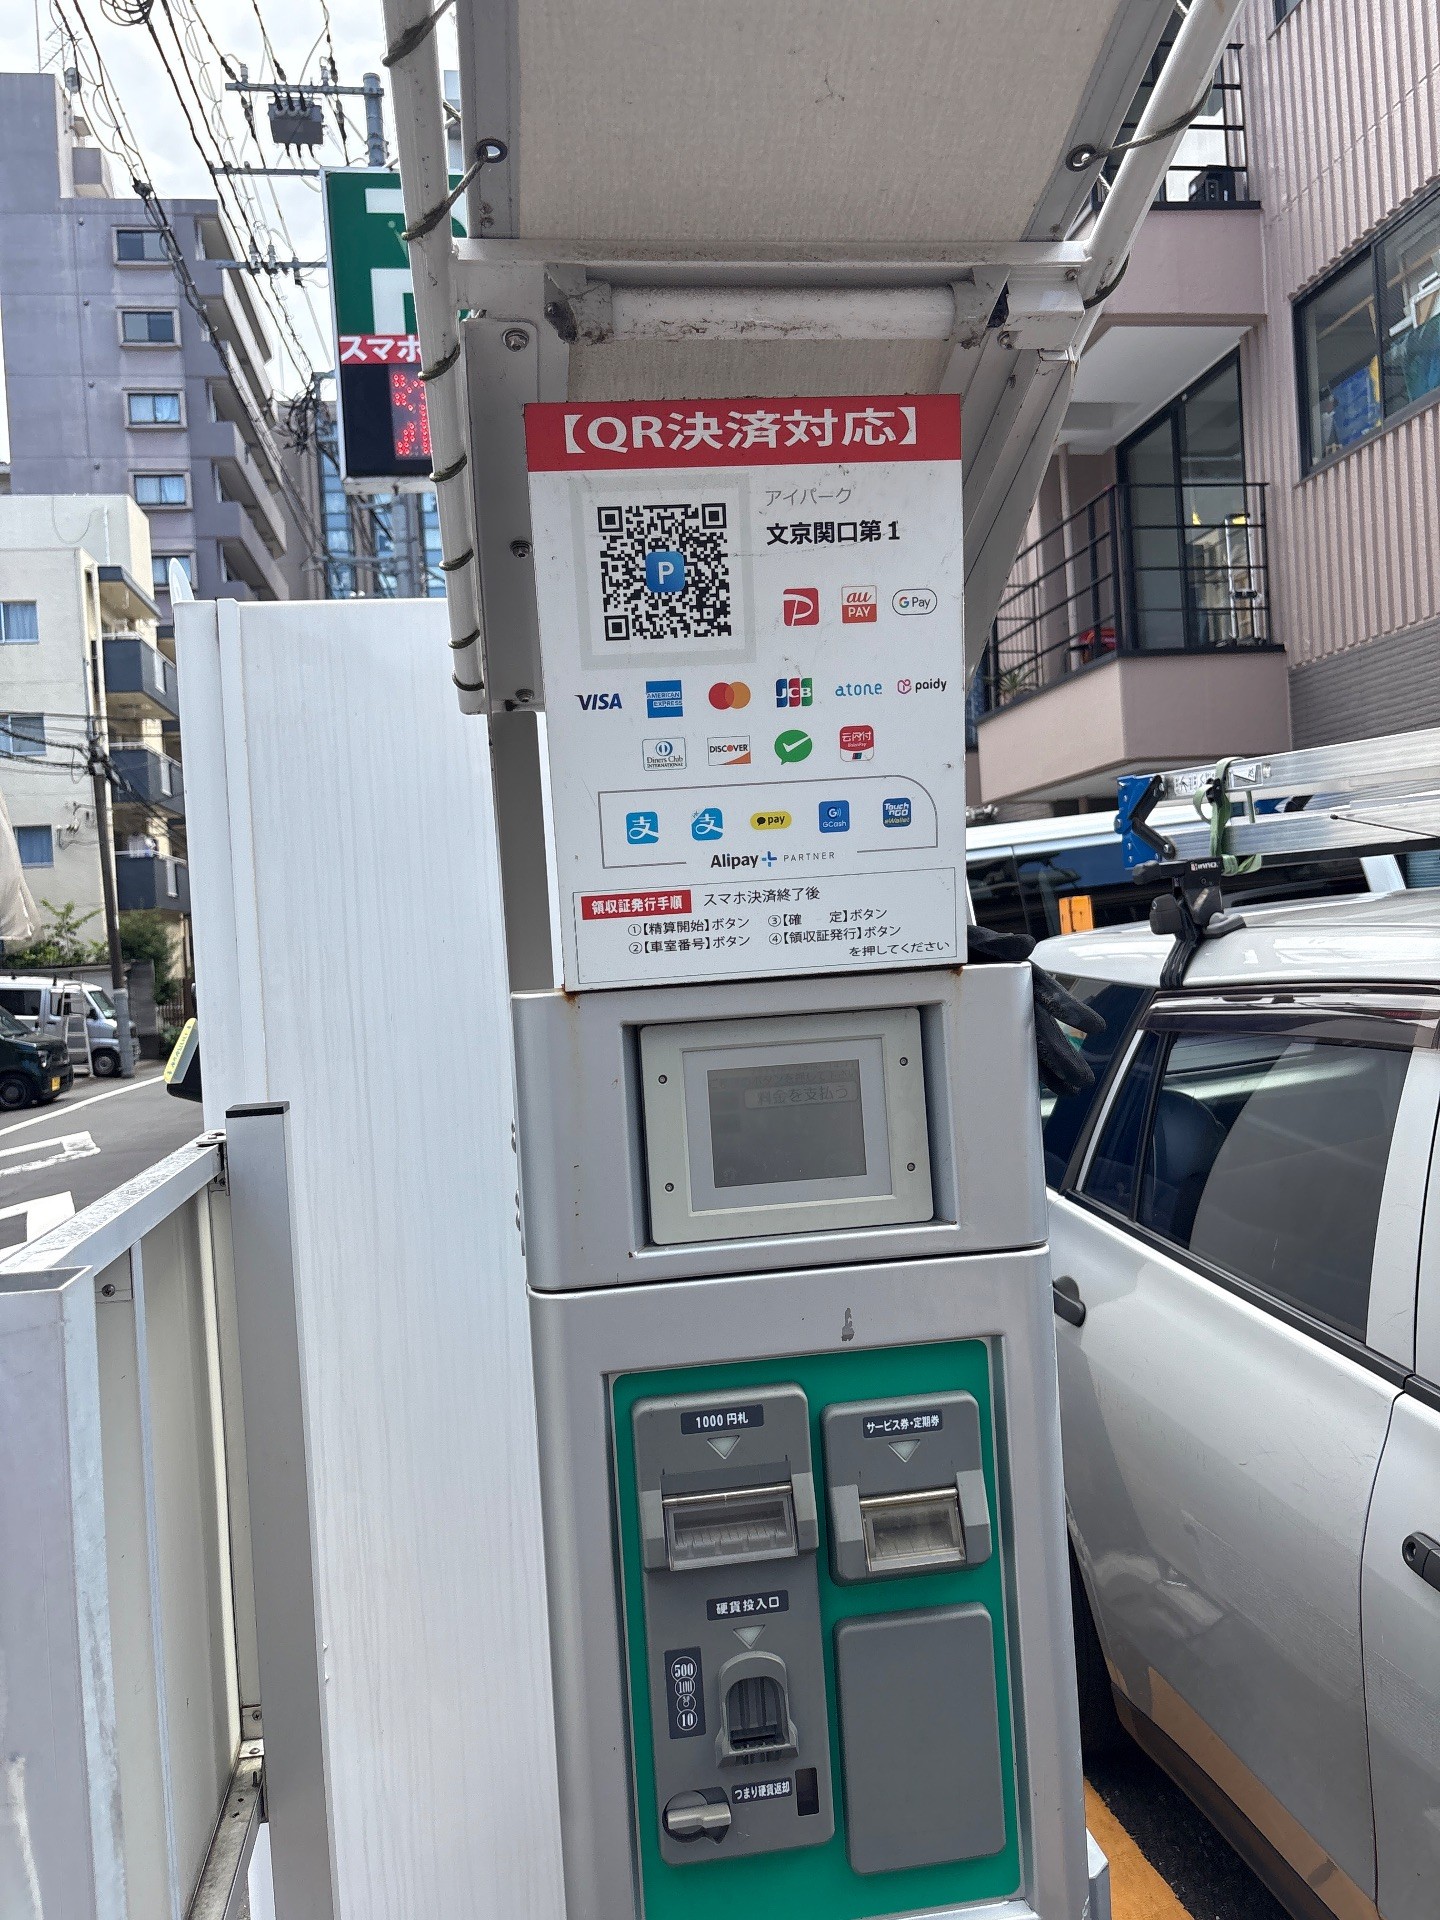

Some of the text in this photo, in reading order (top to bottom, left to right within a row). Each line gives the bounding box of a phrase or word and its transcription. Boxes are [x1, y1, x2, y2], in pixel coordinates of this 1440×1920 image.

[564, 406, 918, 454] 【QR決済対応】
[765, 487, 852, 507] アイパーク
[846, 591, 872, 603] au
[911, 597, 931, 609] Pay
[847, 606, 871, 617] PAY
[775, 681, 812, 700] JCB
[835, 683, 882, 697] atone
[915, 678, 947, 694] paidy
[573, 693, 622, 711] VISA
[646, 691, 681, 699] AMERICAN
[653, 700, 683, 708] EXPRESS
[709, 744, 749, 753] DISCOVER
[884, 802, 910, 811] Touch
[767, 815, 786, 825] pay
[822, 820, 847, 828] GCash
[710, 851, 836, 870] Alipay PARTNER
[703, 886, 821, 907] スマホ決済終了後
[591, 895, 683, 915] 領収証発行手順
[848, 940, 951, 957] を押してください
[757, 1085, 849, 1106] 料金を支払う
[866, 1414, 940, 1434] サービス券・定期券
[715, 1596, 780, 1615] 硬貨投入口
[674, 1662, 694, 1678] 500
[678, 1680, 693, 1694] 100
[681, 1712, 694, 1727] 10
[734, 1780, 790, 1800] つまり硬貨返却
